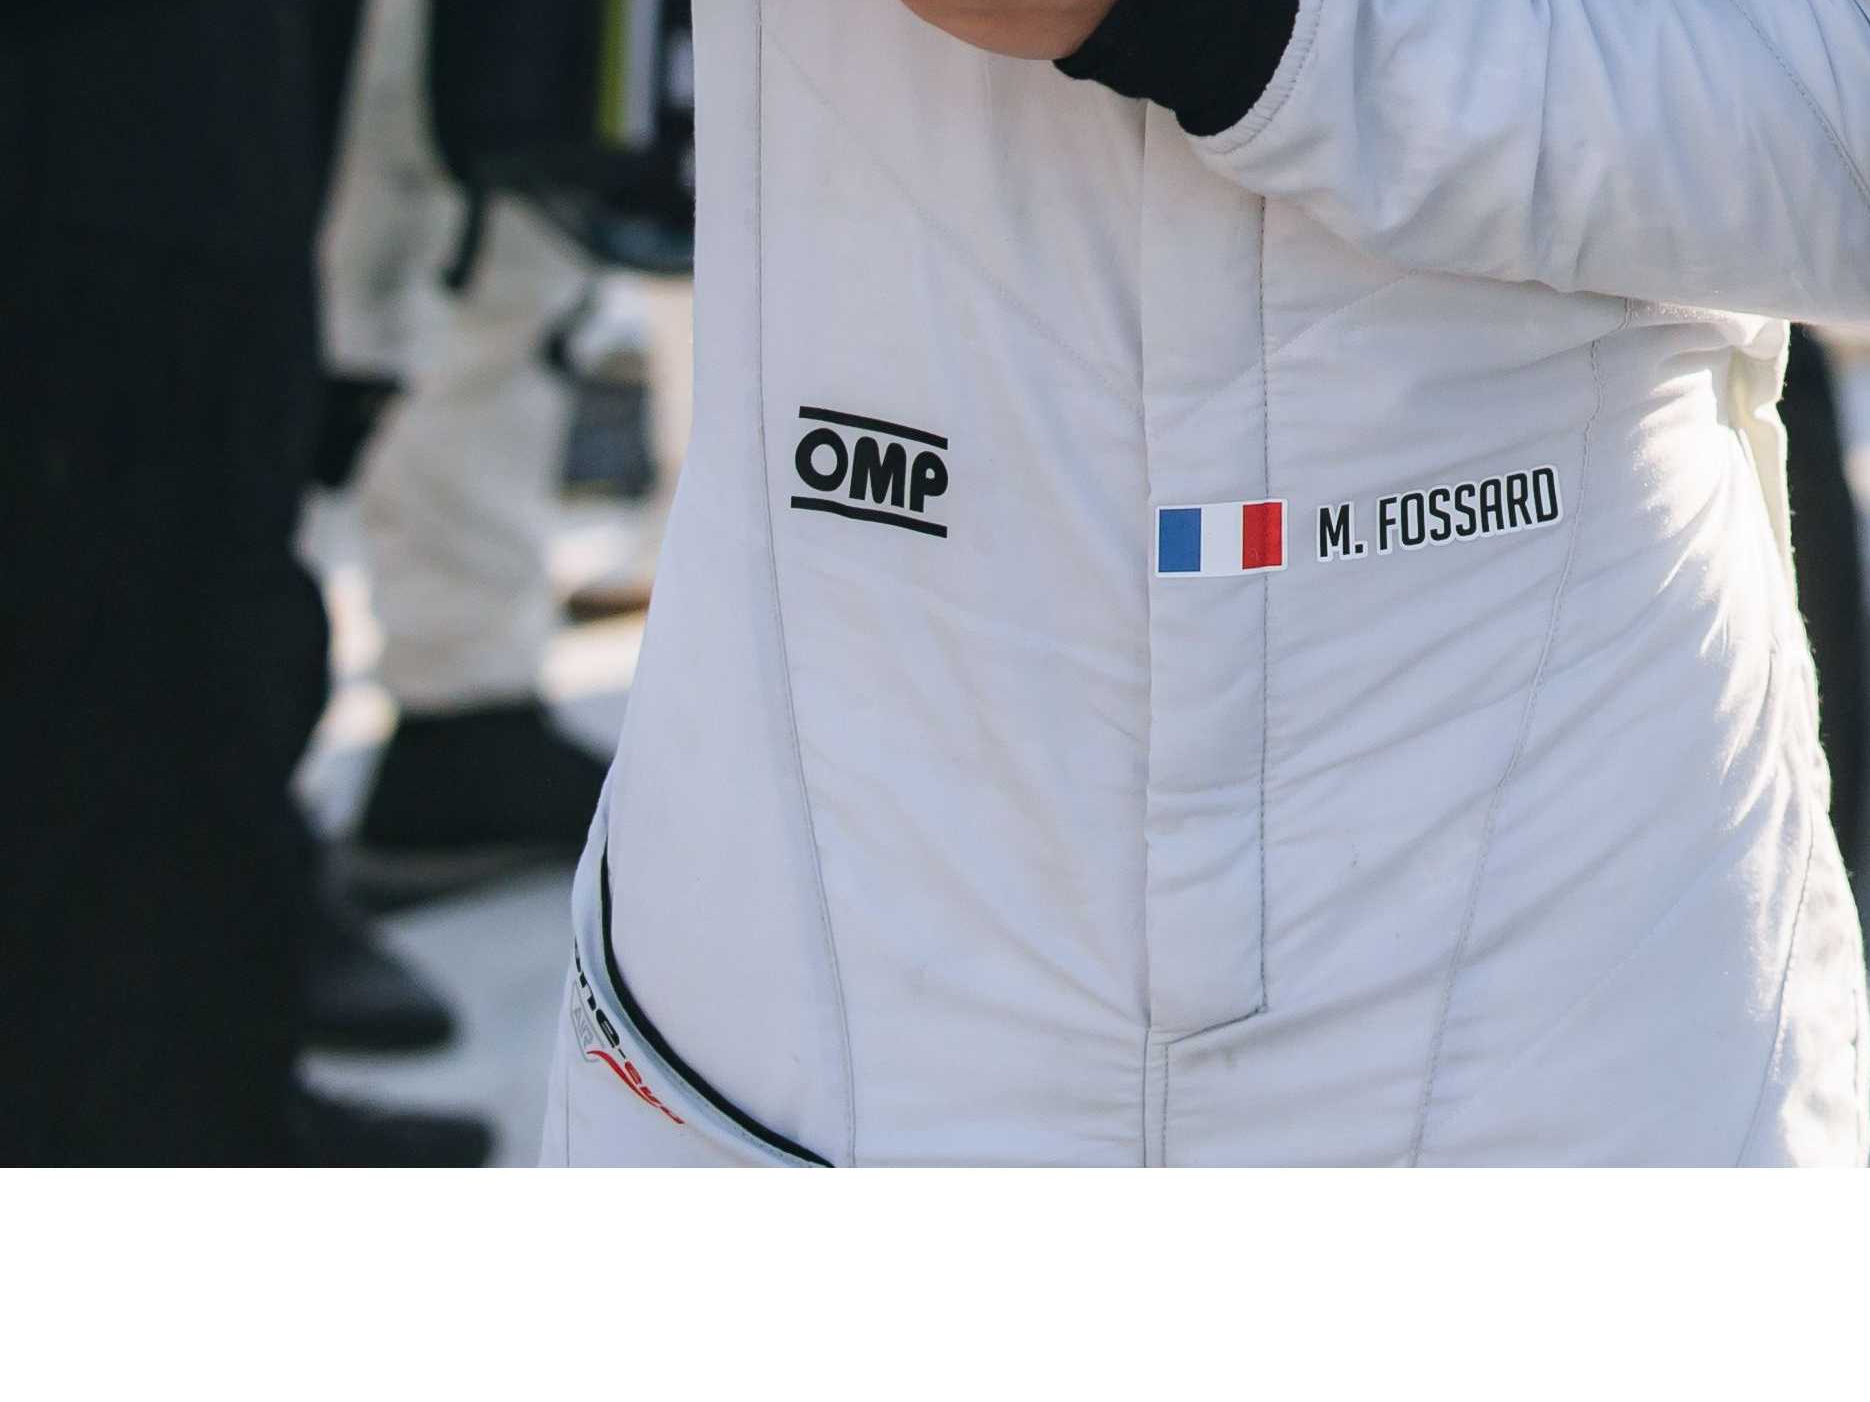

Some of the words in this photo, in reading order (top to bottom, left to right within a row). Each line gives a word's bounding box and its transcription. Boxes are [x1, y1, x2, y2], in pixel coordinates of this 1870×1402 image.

[794, 427, 949, 513] OMP
[1319, 501, 1364, 557] M.
[1378, 467, 1559, 549] FOSSARD
